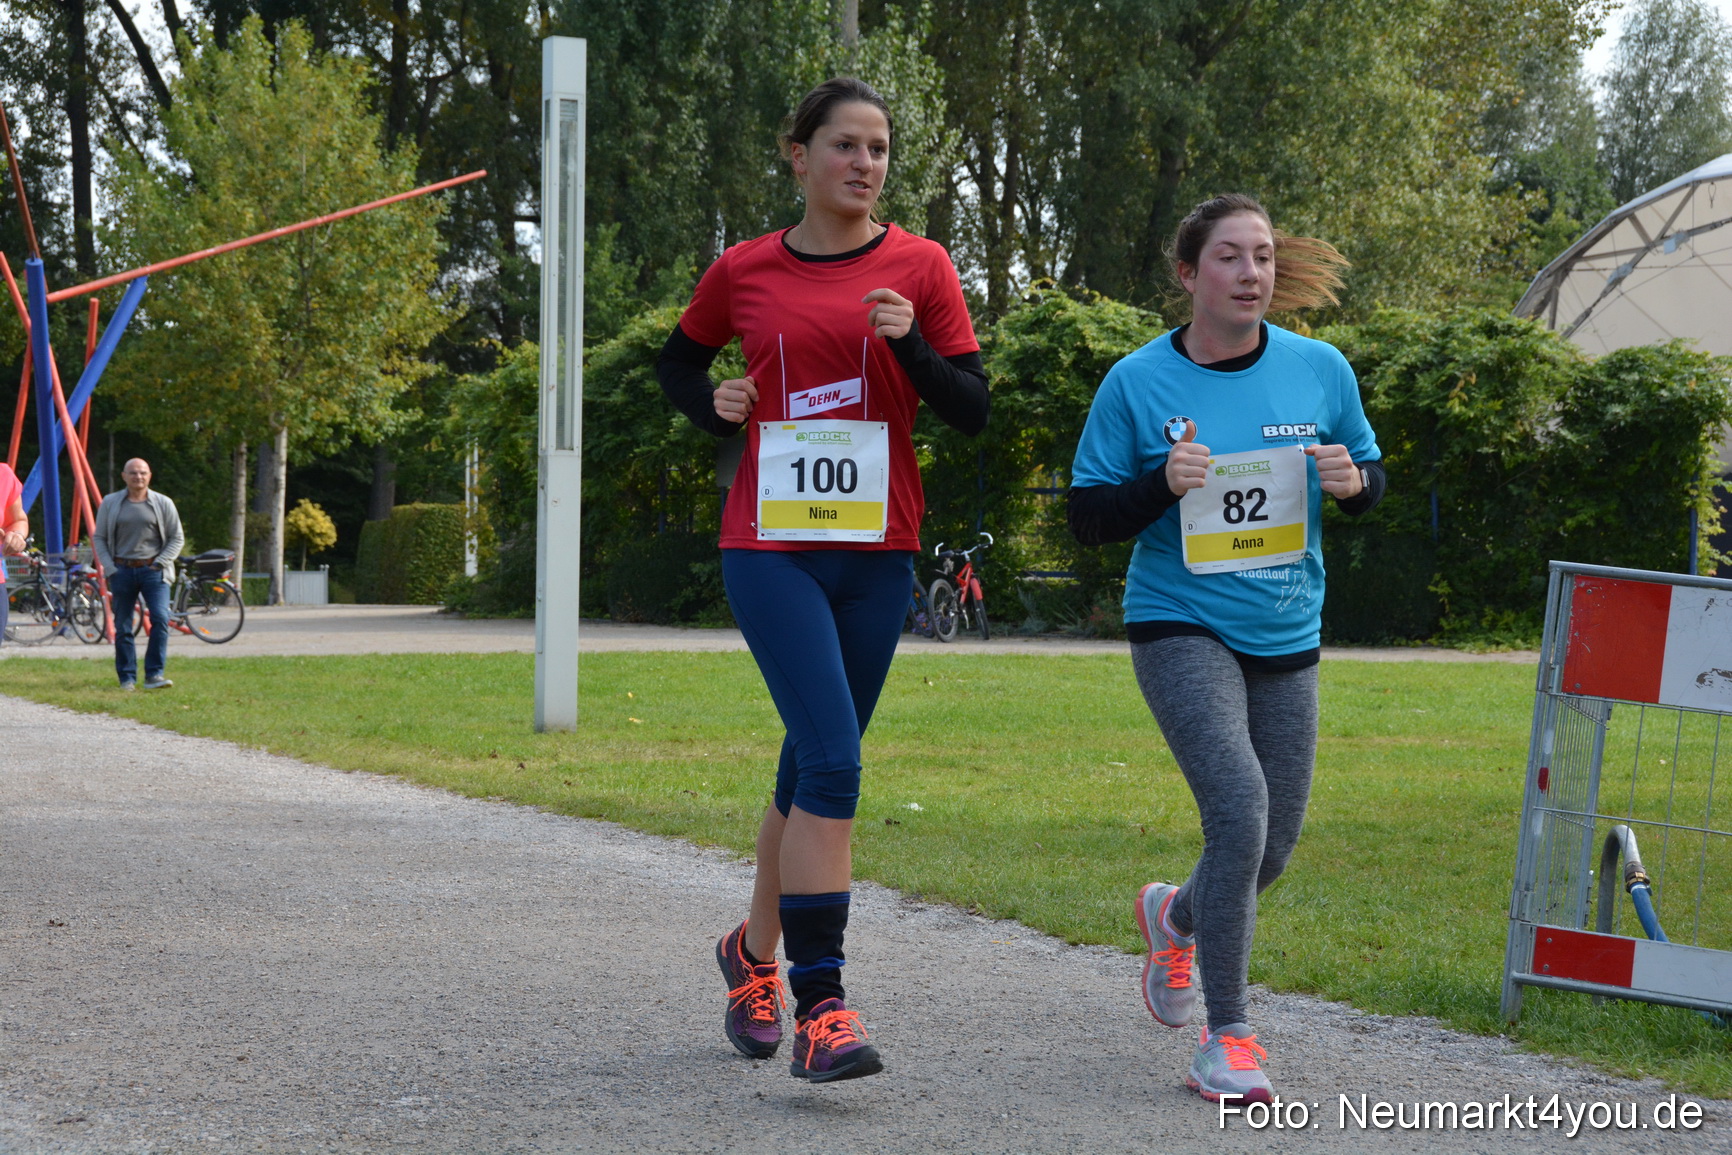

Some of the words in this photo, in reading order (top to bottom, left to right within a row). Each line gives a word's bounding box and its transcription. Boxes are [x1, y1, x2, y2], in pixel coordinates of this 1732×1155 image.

[808, 390, 841, 407] DEHN
[808, 431, 852, 442] BOCK
[1262, 423, 1318, 438] BOCK
[791, 457, 858, 493] 100
[1228, 461, 1271, 475] BOCK
[809, 506, 838, 520] Nina
[1223, 487, 1269, 525] 82
[1232, 537, 1264, 550] Anna
[1235, 568, 1290, 582] Stadtlauf
